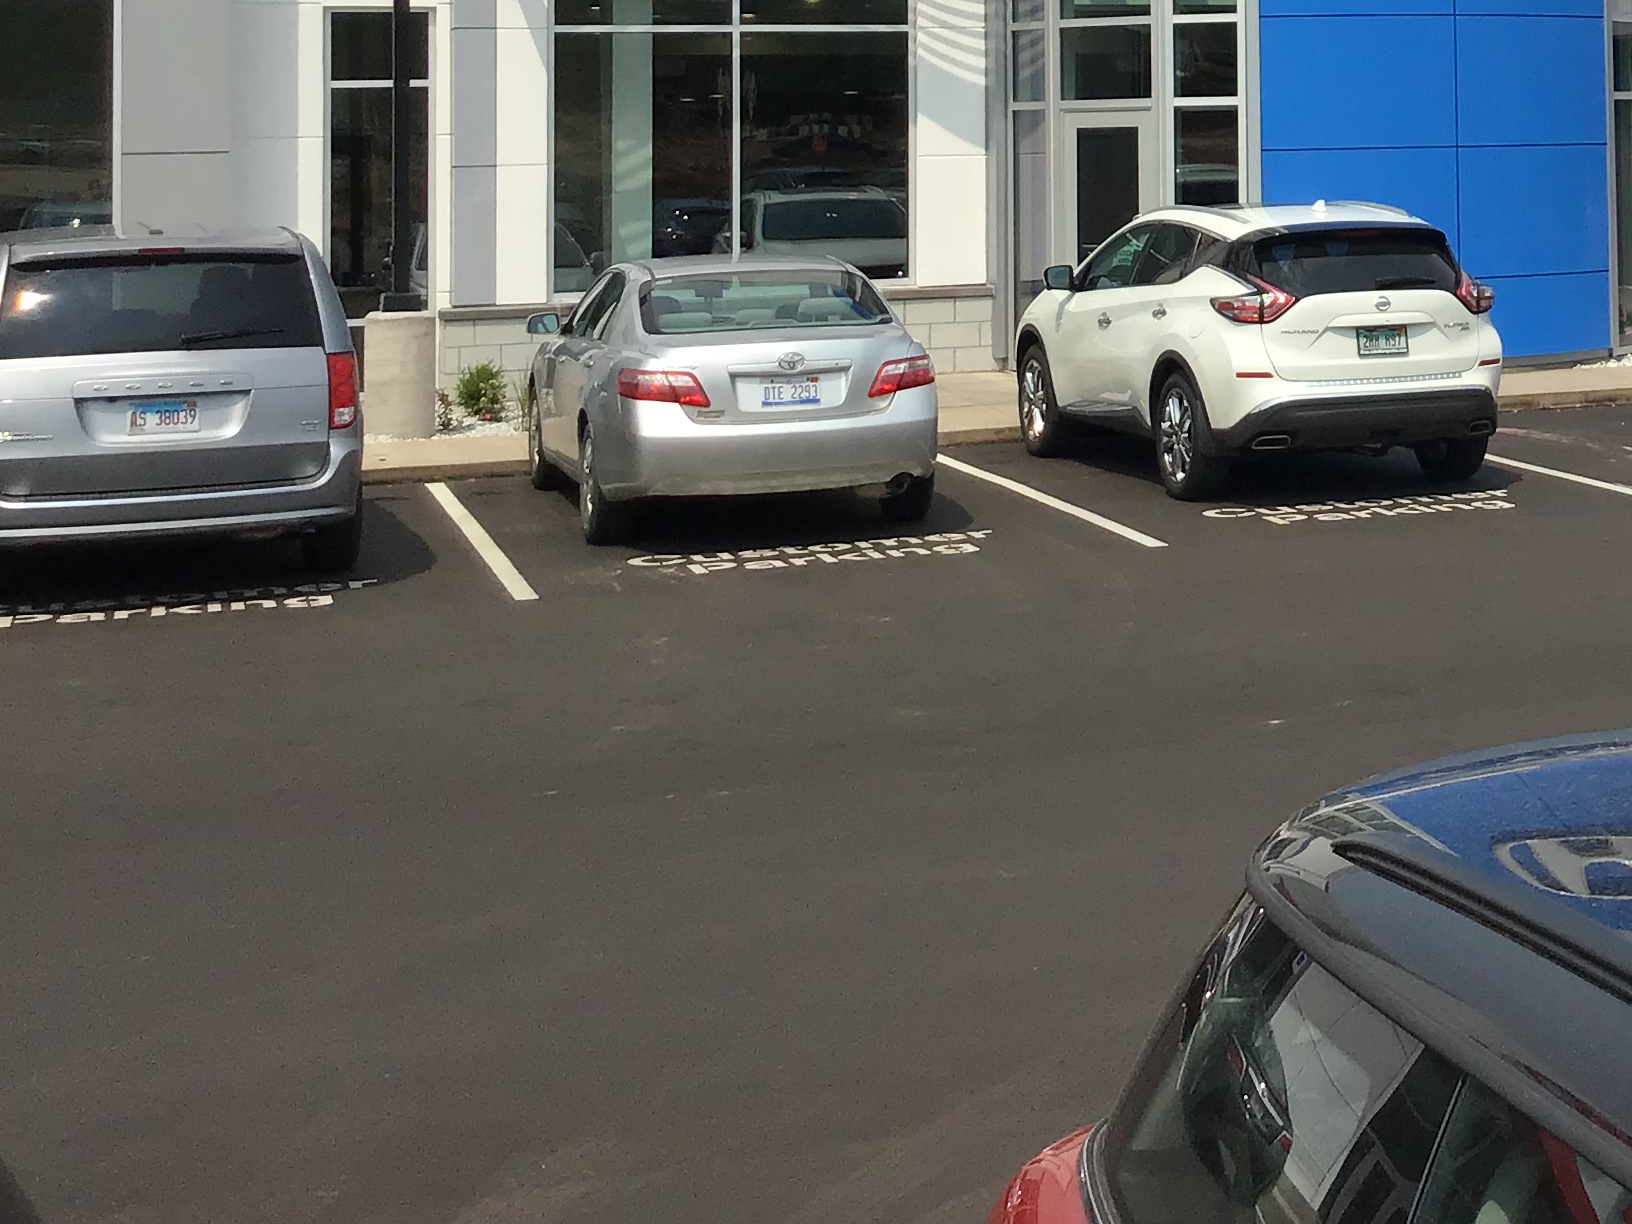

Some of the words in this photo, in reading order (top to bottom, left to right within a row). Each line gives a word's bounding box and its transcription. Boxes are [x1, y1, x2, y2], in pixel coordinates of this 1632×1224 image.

[791, 384, 818, 400] 2293
[130, 411, 147, 428] AS
[155, 408, 197, 427] 38039
[627, 529, 992, 566] Customer
